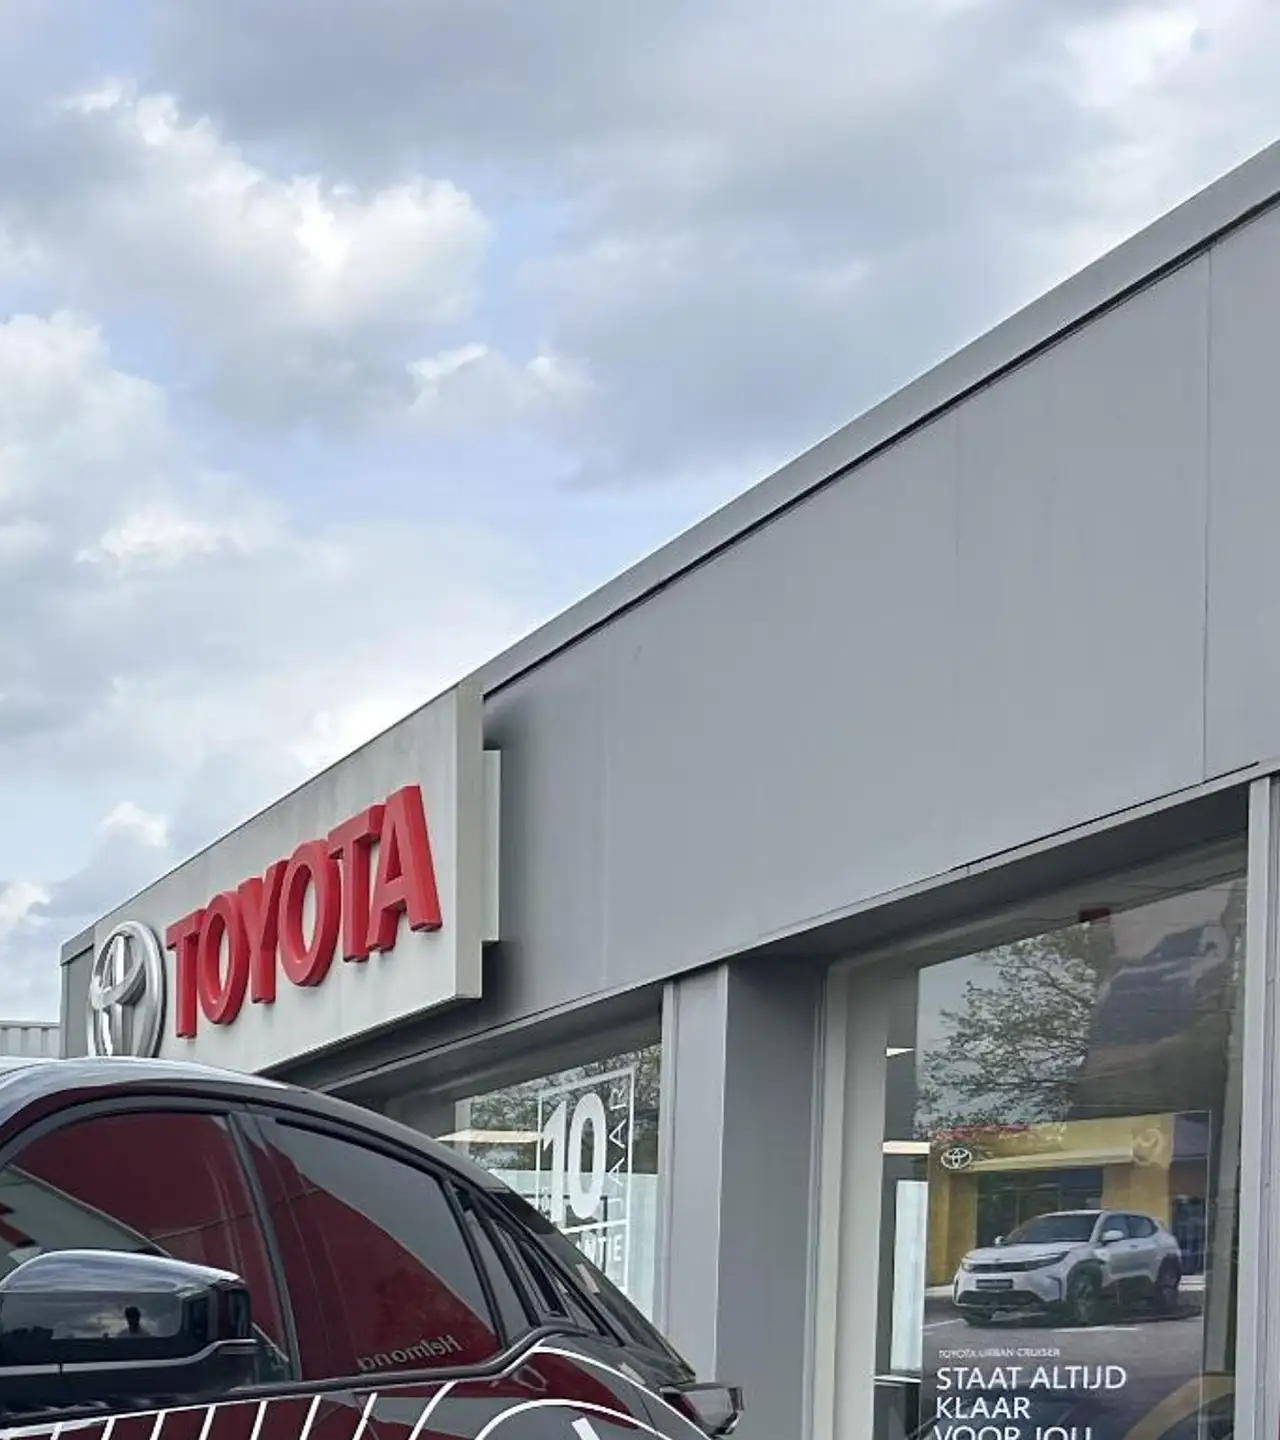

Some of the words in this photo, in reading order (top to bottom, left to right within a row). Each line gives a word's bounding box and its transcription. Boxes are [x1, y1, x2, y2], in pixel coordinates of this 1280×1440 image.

[165, 784, 443, 1039] TOYOTA
[543, 1092, 607, 1222] 10
[935, 1365, 1023, 1390] STAAT
[1029, 1364, 1127, 1390] ALTIJD
[935, 1396, 1031, 1420] KLAAR
